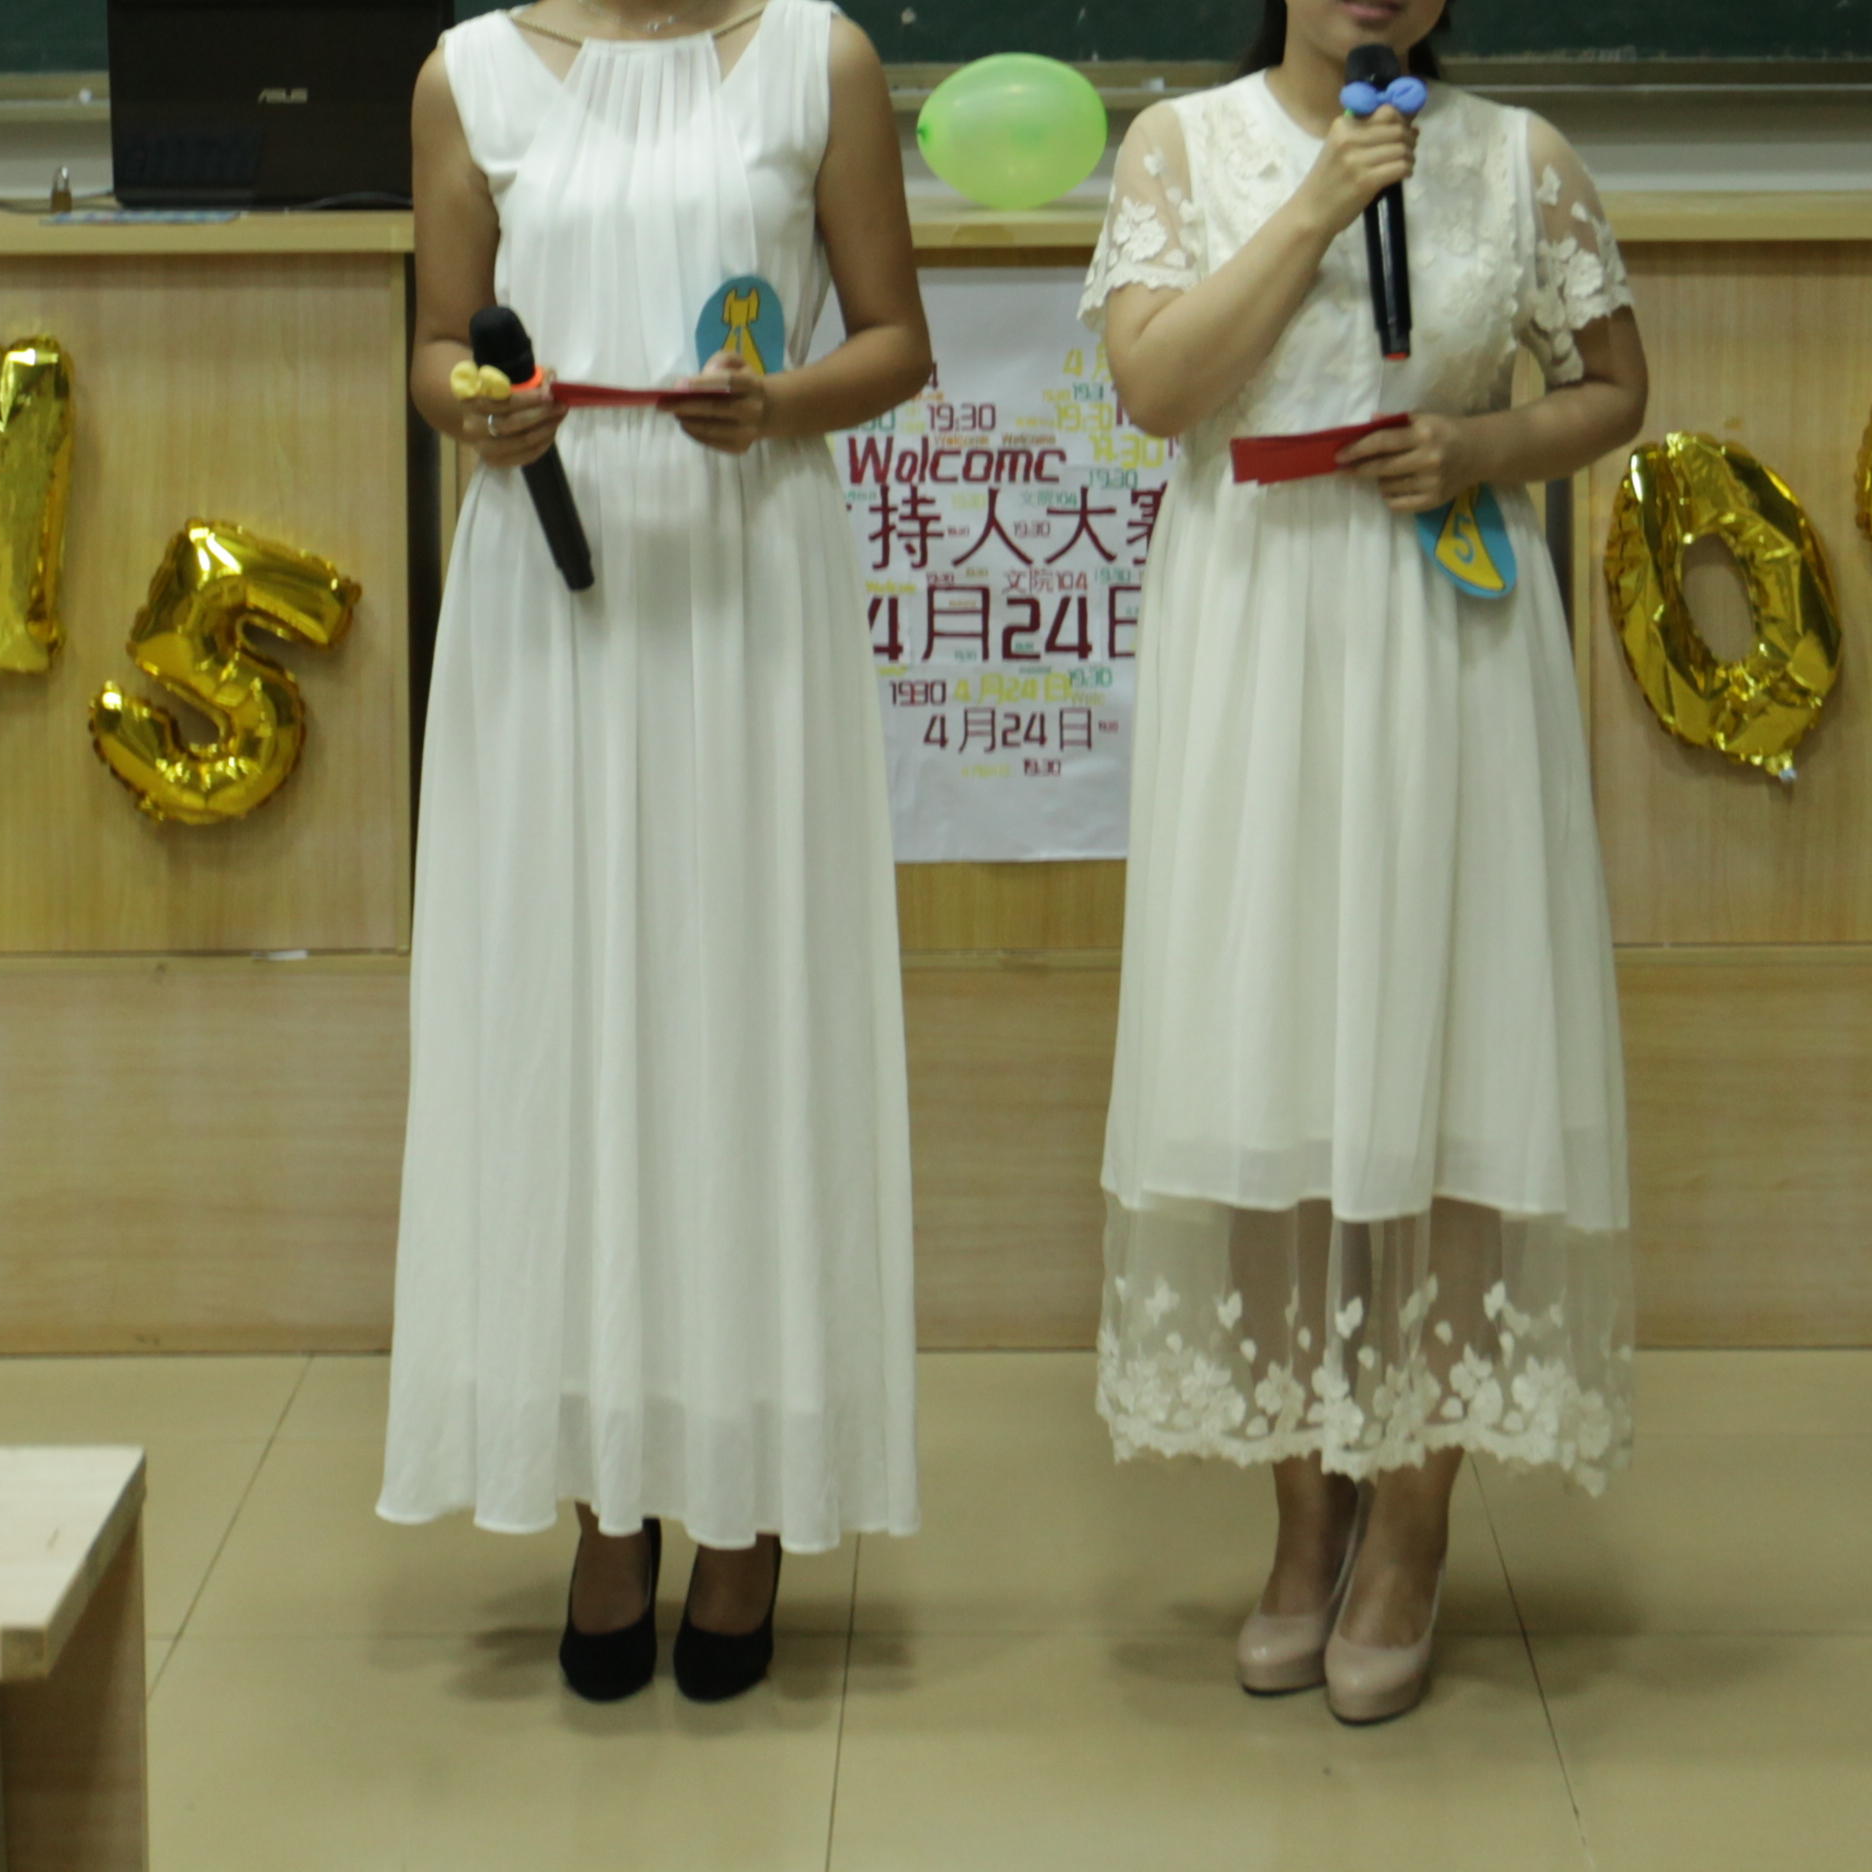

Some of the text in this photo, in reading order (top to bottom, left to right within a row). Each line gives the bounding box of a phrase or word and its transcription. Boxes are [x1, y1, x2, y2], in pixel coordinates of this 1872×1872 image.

[257, 87, 309, 104] ASUS
[1453, 511, 1476, 566] 5
[923, 706, 1093, 754] 4月24日
